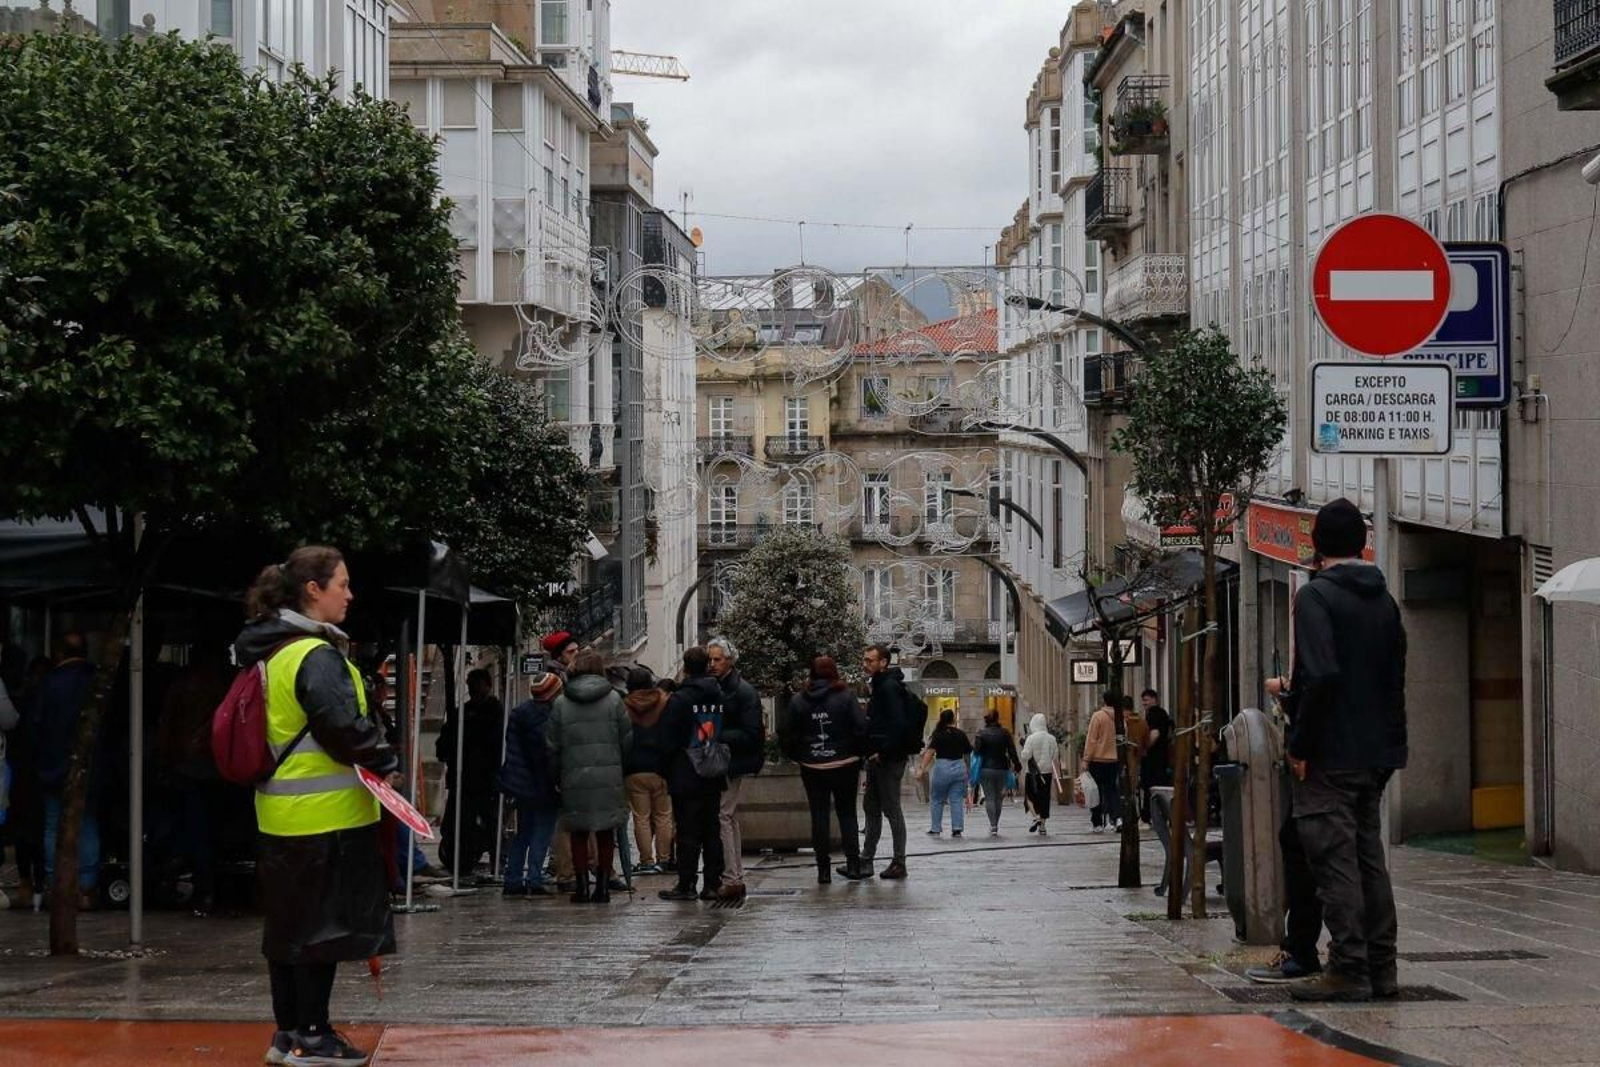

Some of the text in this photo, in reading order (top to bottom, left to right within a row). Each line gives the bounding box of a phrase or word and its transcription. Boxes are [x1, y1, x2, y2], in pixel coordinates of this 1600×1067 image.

[1355, 376, 1406, 388] EXCEPTO
[1326, 393, 1436, 406] CARGA / DESCARGA
[1326, 411, 1435, 422] DE 08:00 A 11:00 H.
[1389, 428, 1395, 440] E
[1398, 428, 1430, 440] TAXIS
[1162, 535, 1190, 545] PRECIOS
